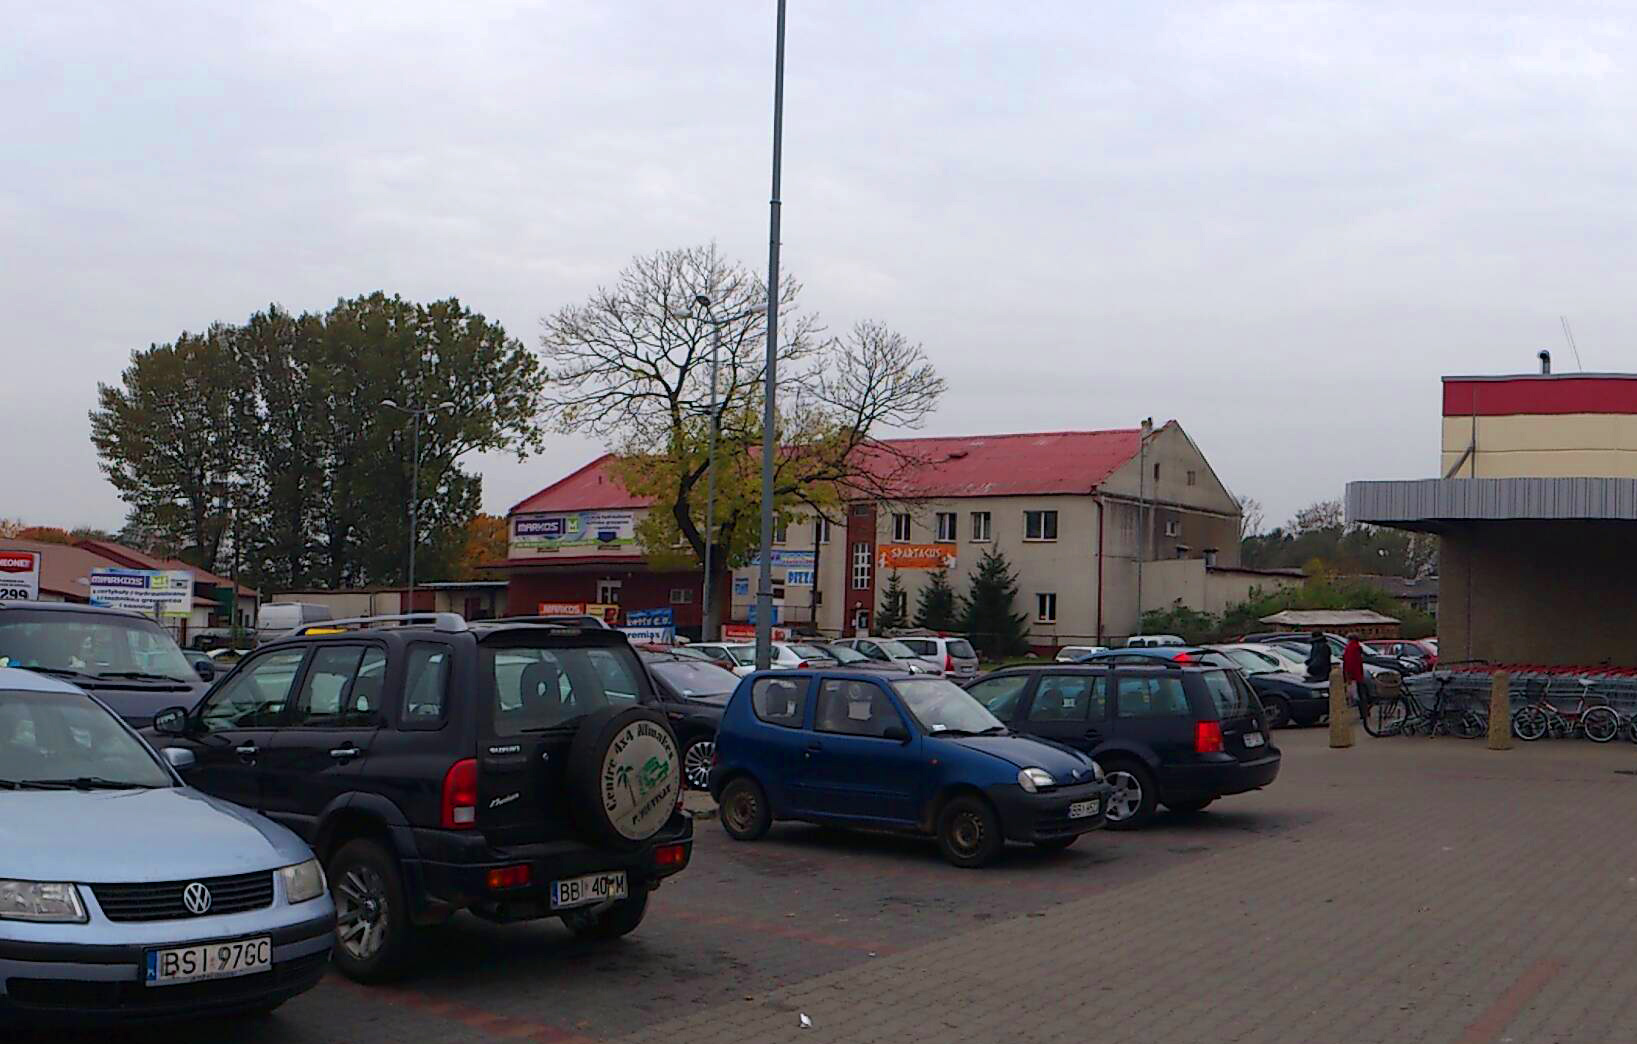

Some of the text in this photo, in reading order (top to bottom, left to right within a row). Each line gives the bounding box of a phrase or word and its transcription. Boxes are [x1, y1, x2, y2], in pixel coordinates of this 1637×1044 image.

[891, 548, 940, 559] SPARTACUS
[606, 758, 618, 811] Centre
[614, 728, 635, 754] 4x4
[637, 723, 674, 760] Allmakes
[164, 940, 269, 976] BSI 97GC
